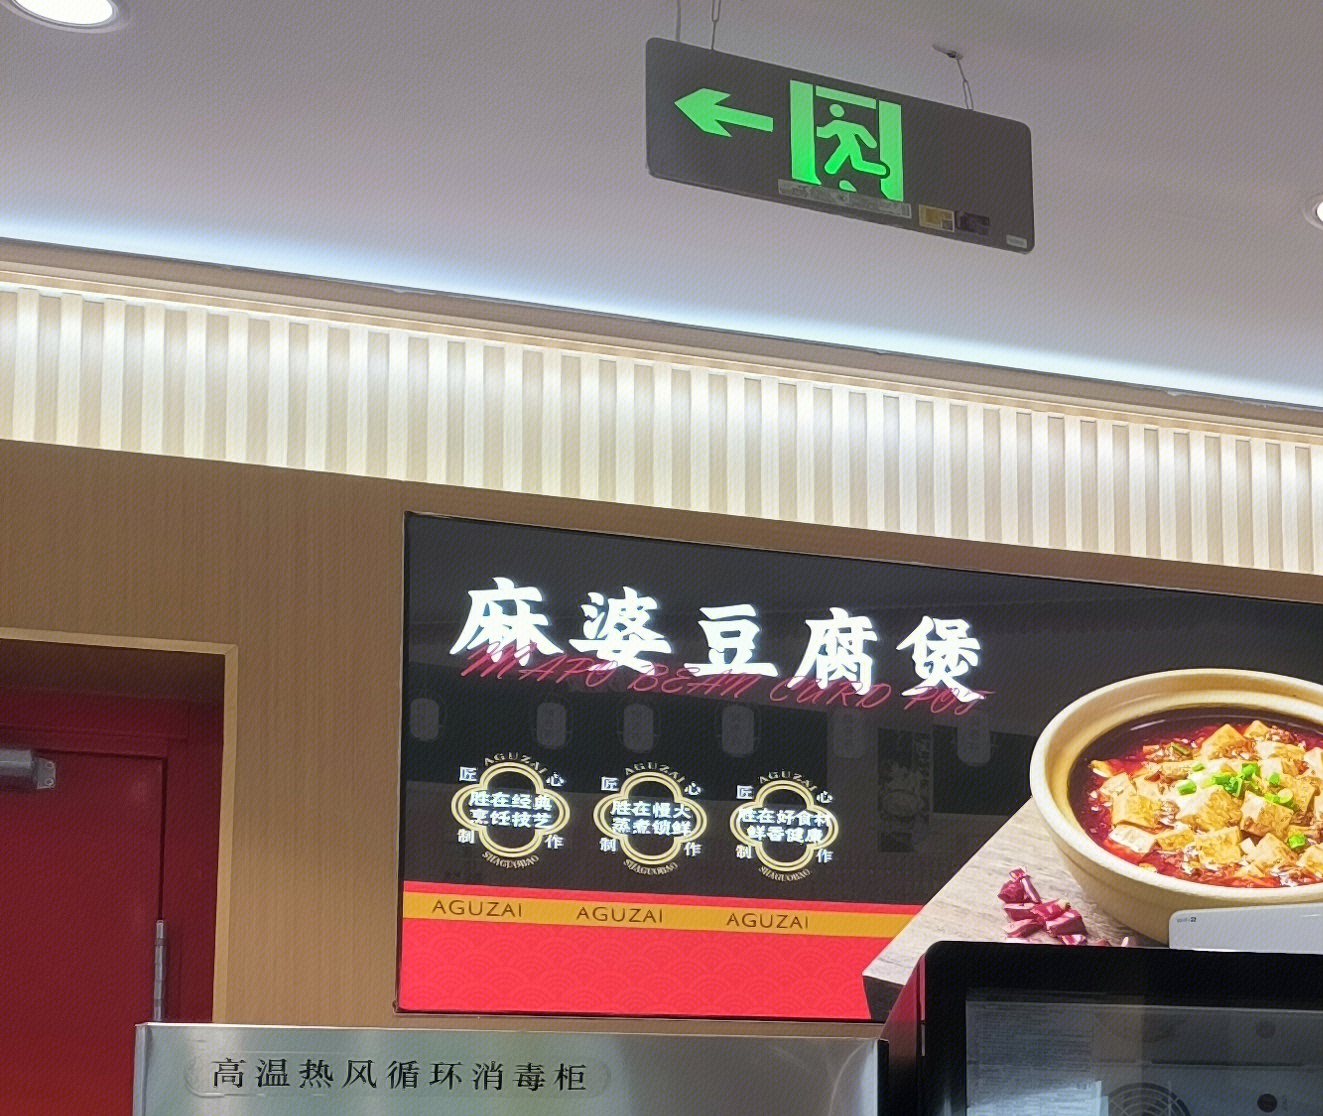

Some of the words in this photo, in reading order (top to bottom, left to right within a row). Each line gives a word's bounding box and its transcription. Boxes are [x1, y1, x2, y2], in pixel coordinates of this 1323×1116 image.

[449, 577, 985, 702] 麻婆豆腐煲
[461, 641, 619, 687] MAPO
[628, 661, 761, 699] BEAN
[770, 675, 892, 709] CURD
[903, 685, 996, 716] POT
[431, 898, 524, 919] AGUZAI
[575, 905, 664, 925] AGUZAI
[726, 911, 810, 930] AGUZAI
[211, 1057, 588, 1093] 高温热风循环消毒柜
